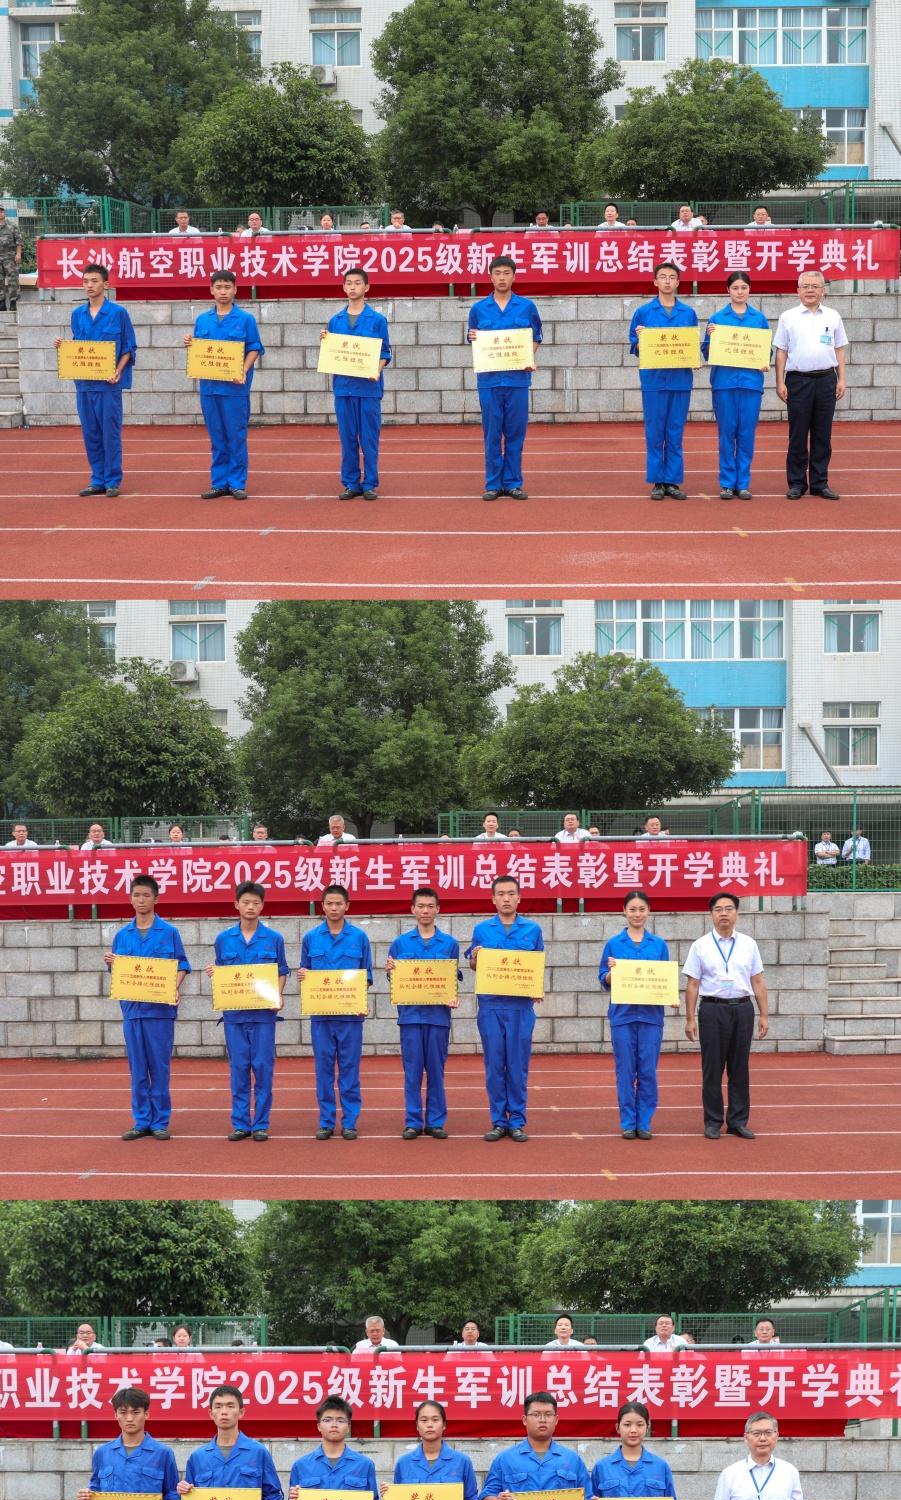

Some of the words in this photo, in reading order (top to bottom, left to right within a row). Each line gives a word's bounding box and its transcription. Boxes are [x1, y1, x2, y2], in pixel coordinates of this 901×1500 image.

[0, 850, 784, 896] 职业技术学院2025级新生军训总结表彰暨开学典礼
[0, 1364, 901, 1409] 职业技术学院2025级新生军训总结表彰暨开学典
